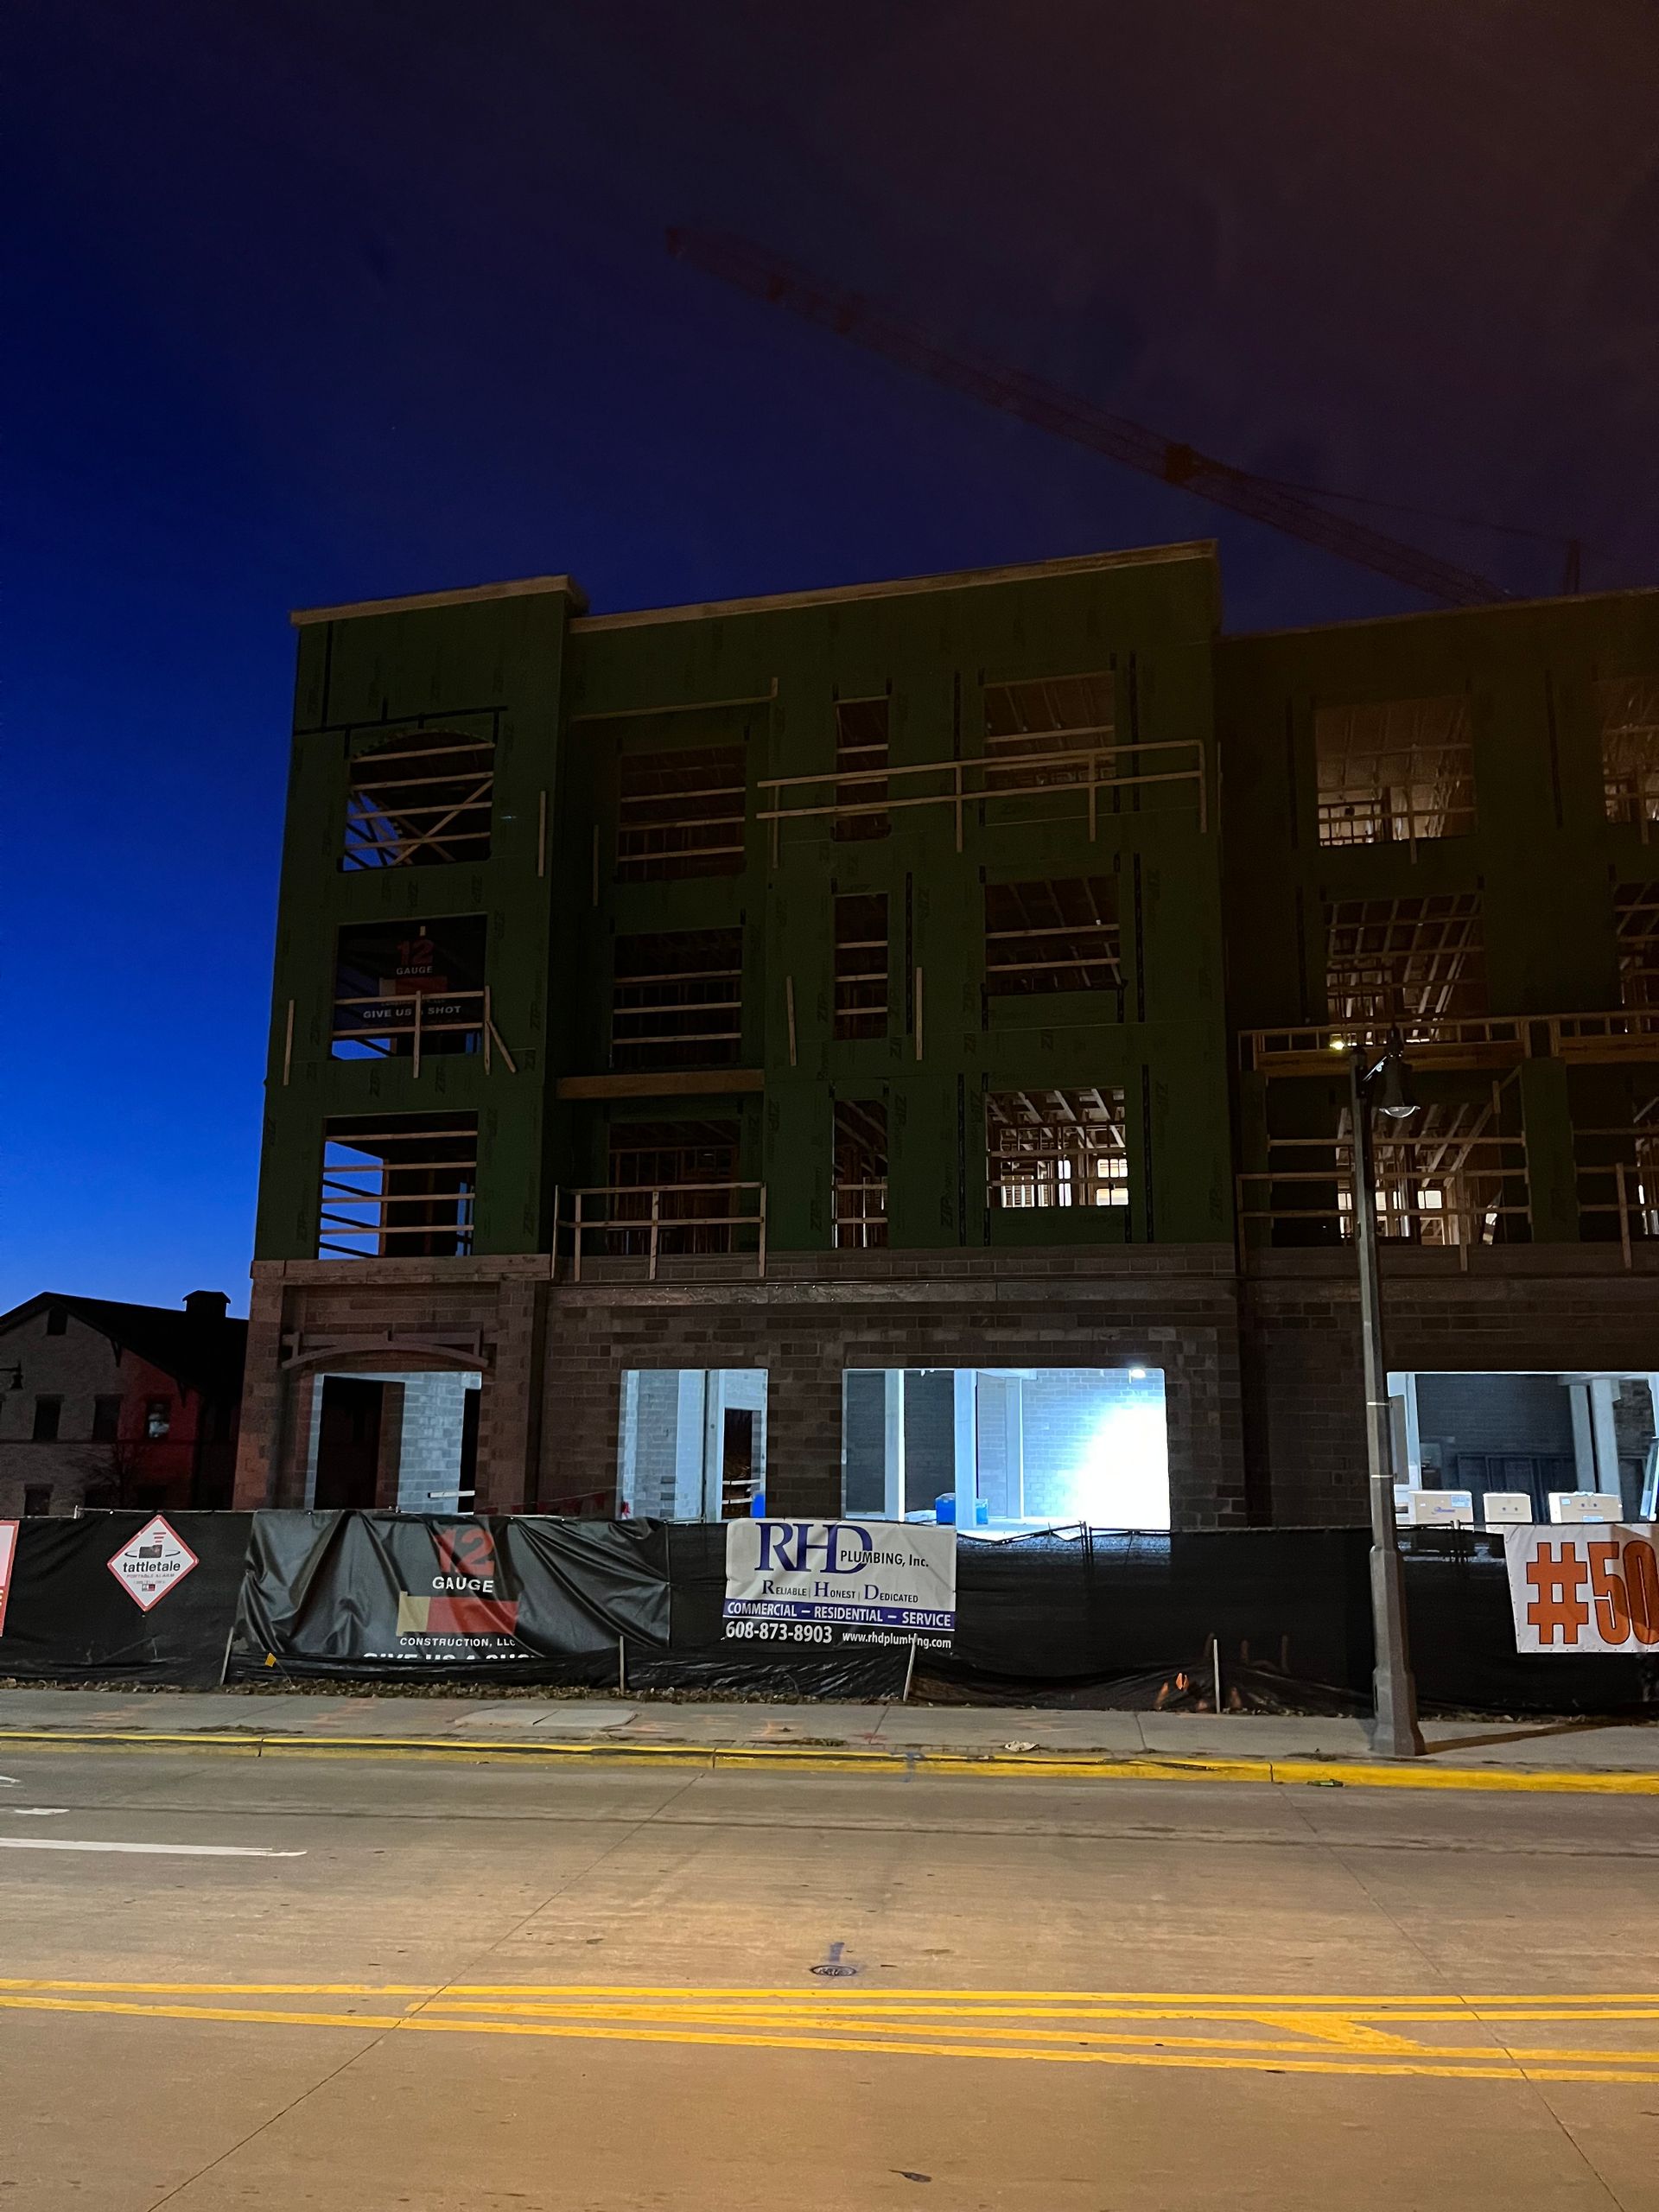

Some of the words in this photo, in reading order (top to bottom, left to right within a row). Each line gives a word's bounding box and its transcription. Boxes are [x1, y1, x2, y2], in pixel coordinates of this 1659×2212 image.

[397, 938, 435, 966] 12
[396, 965, 433, 976] GAUGE
[363, 1008, 391, 1019] GIVE
[396, 1007, 412, 1017] US
[428, 1005, 461, 1015] SHOT
[435, 1527, 495, 1576] 12
[754, 1522, 873, 1574] RHD
[123, 1560, 181, 1572] tattletale
[840, 1550, 906, 1567] PLUMBING,
[909, 1554, 929, 1567] Inc.
[432, 1576, 494, 1593] GAUGE
[728, 1601, 798, 1618] COMMERCIAL
[814, 1606, 883, 1623] RESIDENTIAL
[901, 1611, 951, 1627] SERVICE
[725, 1620, 833, 1643] 608-873-8903
[400, 1637, 493, 1648] CONSTRUCTION,
